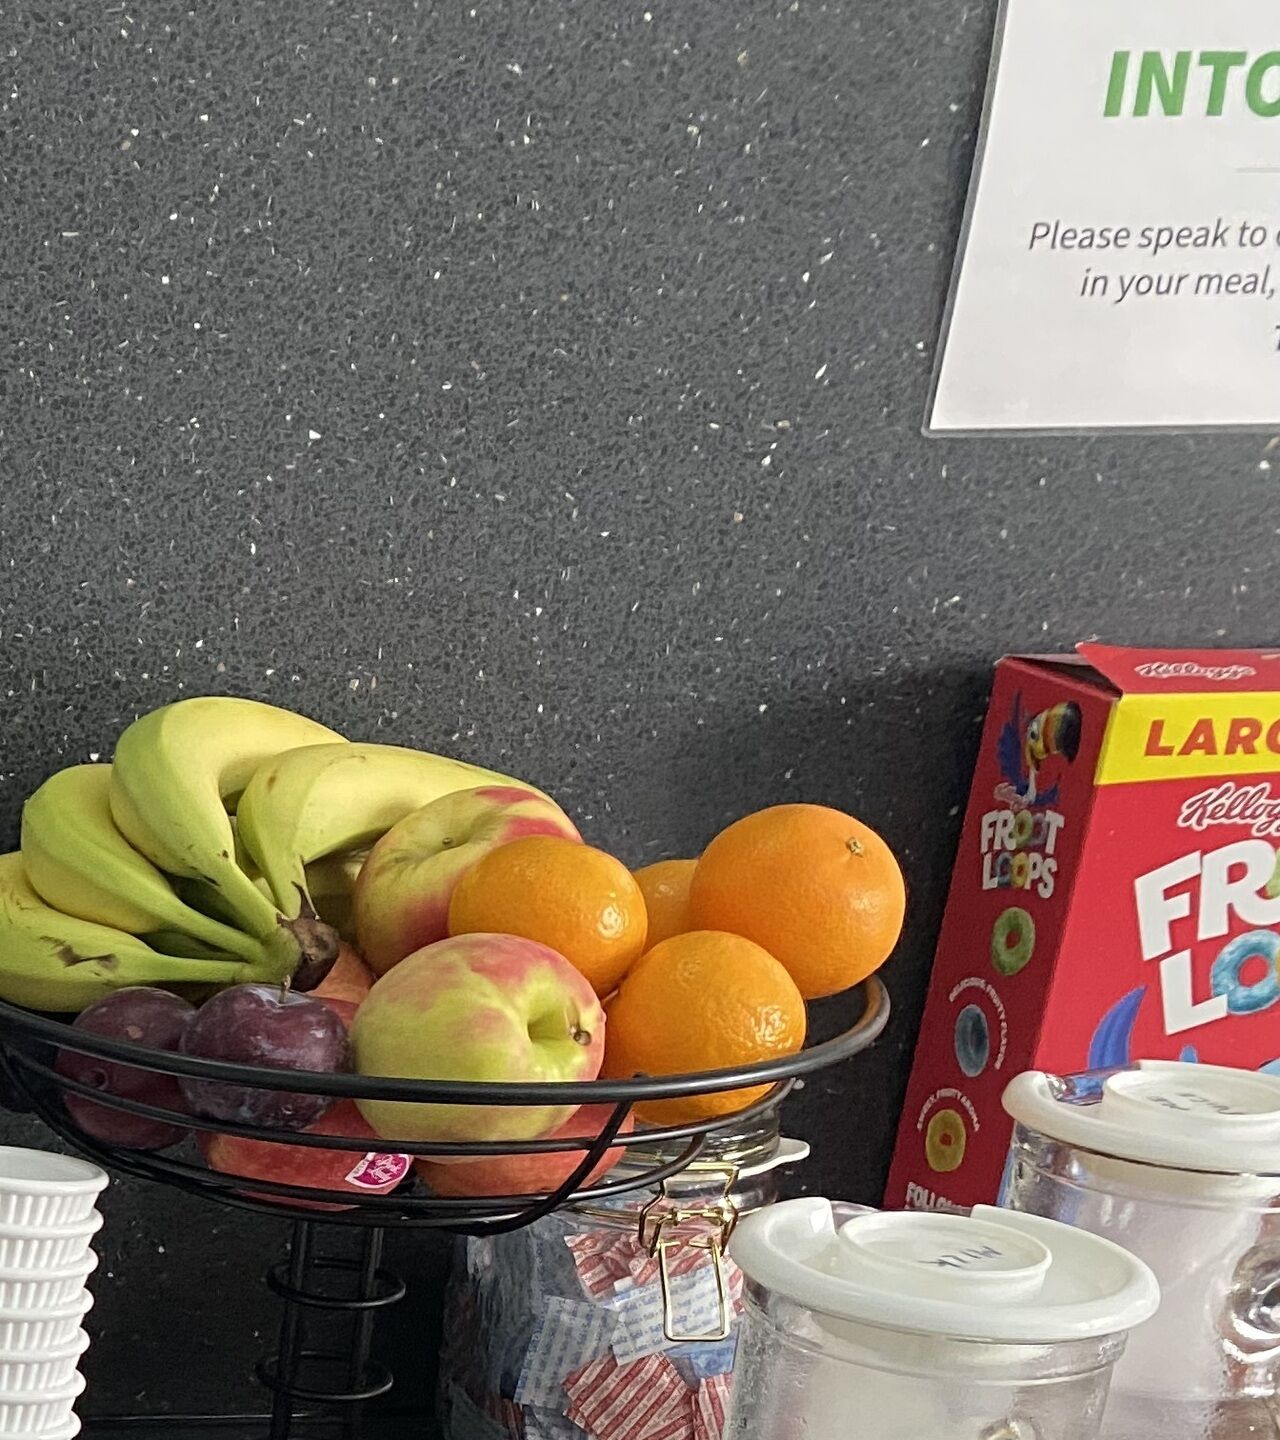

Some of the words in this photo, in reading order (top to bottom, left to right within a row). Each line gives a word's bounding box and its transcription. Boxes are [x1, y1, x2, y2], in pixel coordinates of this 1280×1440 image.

[1029, 220, 1130, 249] Please
[1138, 218, 1229, 256] speak
[1239, 221, 1267, 247] to
[1081, 268, 1108, 296] in
[1115, 274, 1189, 304] your
[1195, 265, 1274, 299] meal,
[980, 809, 1065, 856] FROOT
[982, 851, 1058, 898] LOOPS
